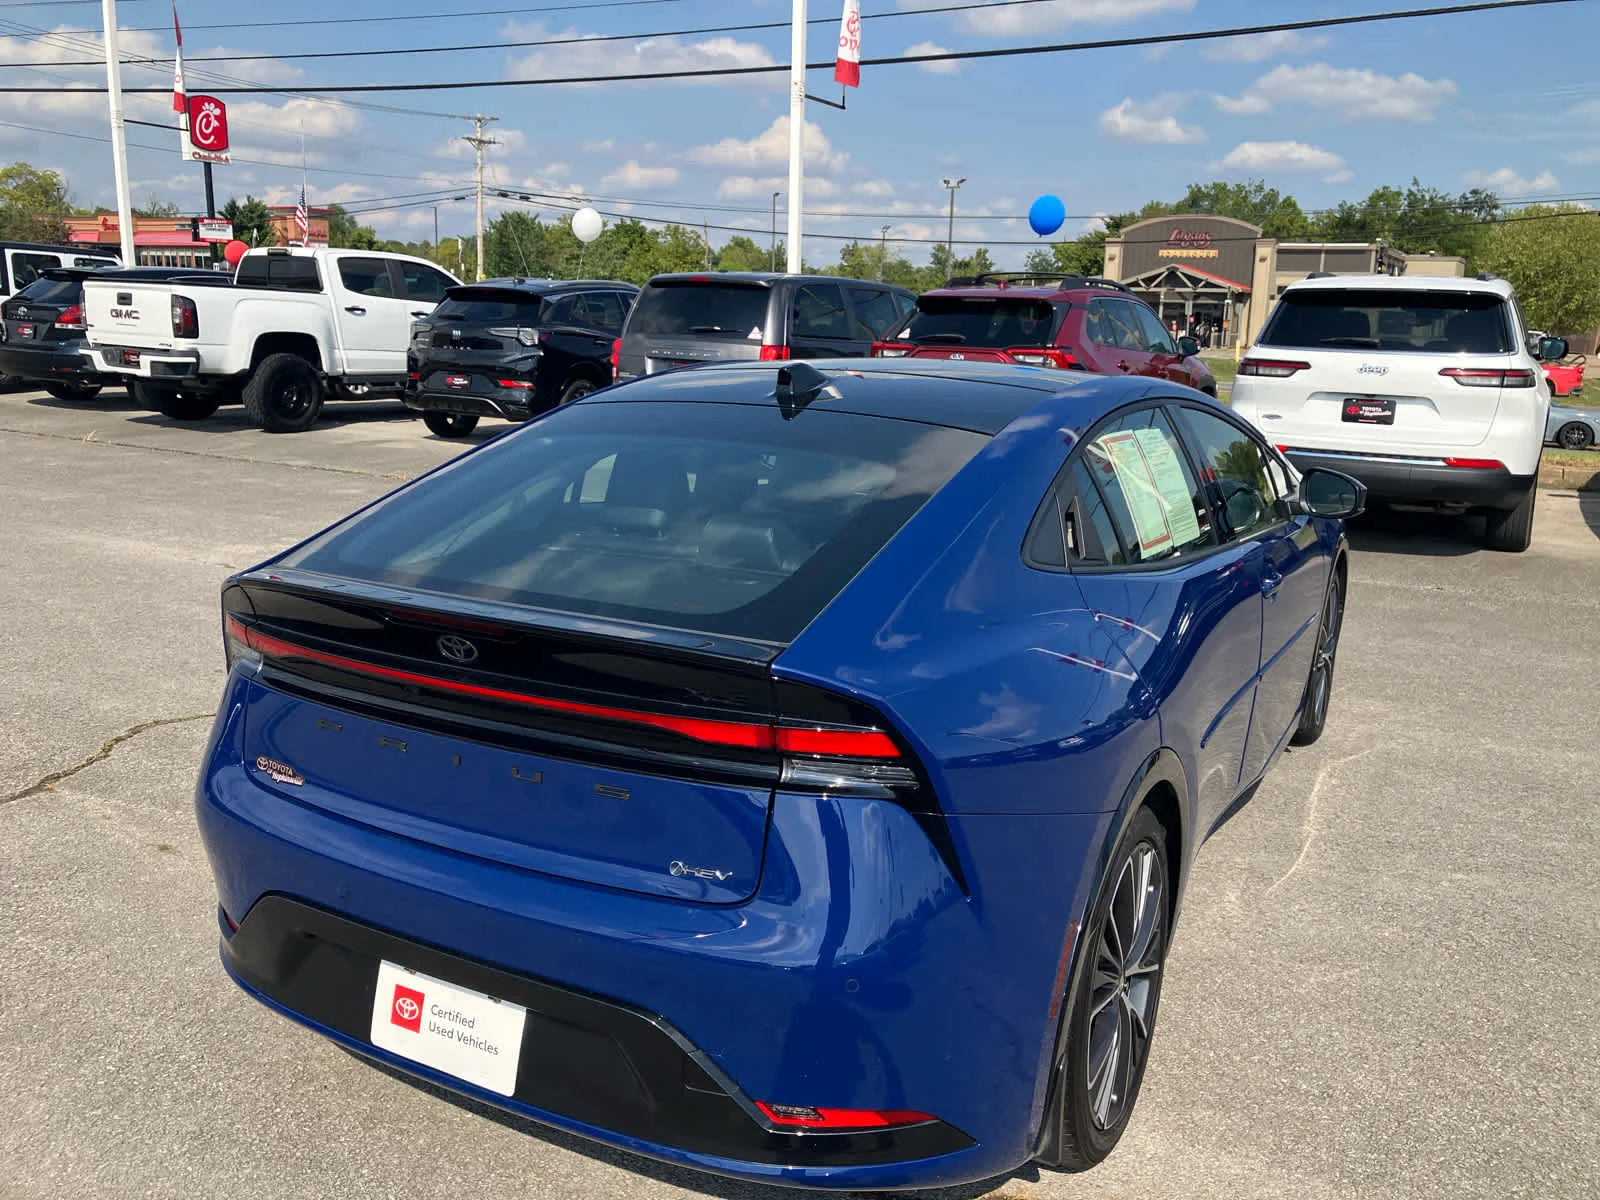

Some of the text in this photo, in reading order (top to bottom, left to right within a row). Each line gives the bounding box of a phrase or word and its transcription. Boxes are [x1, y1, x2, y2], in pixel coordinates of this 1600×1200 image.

[110, 308, 140, 320] GMC
[1357, 363, 1390, 376] Jeep
[268, 760, 293, 776] TOYOTA
[317, 717, 631, 800] PRIUS
[430, 1004, 475, 1029] Certified
[428, 1020, 499, 1055] Used Vehicles
